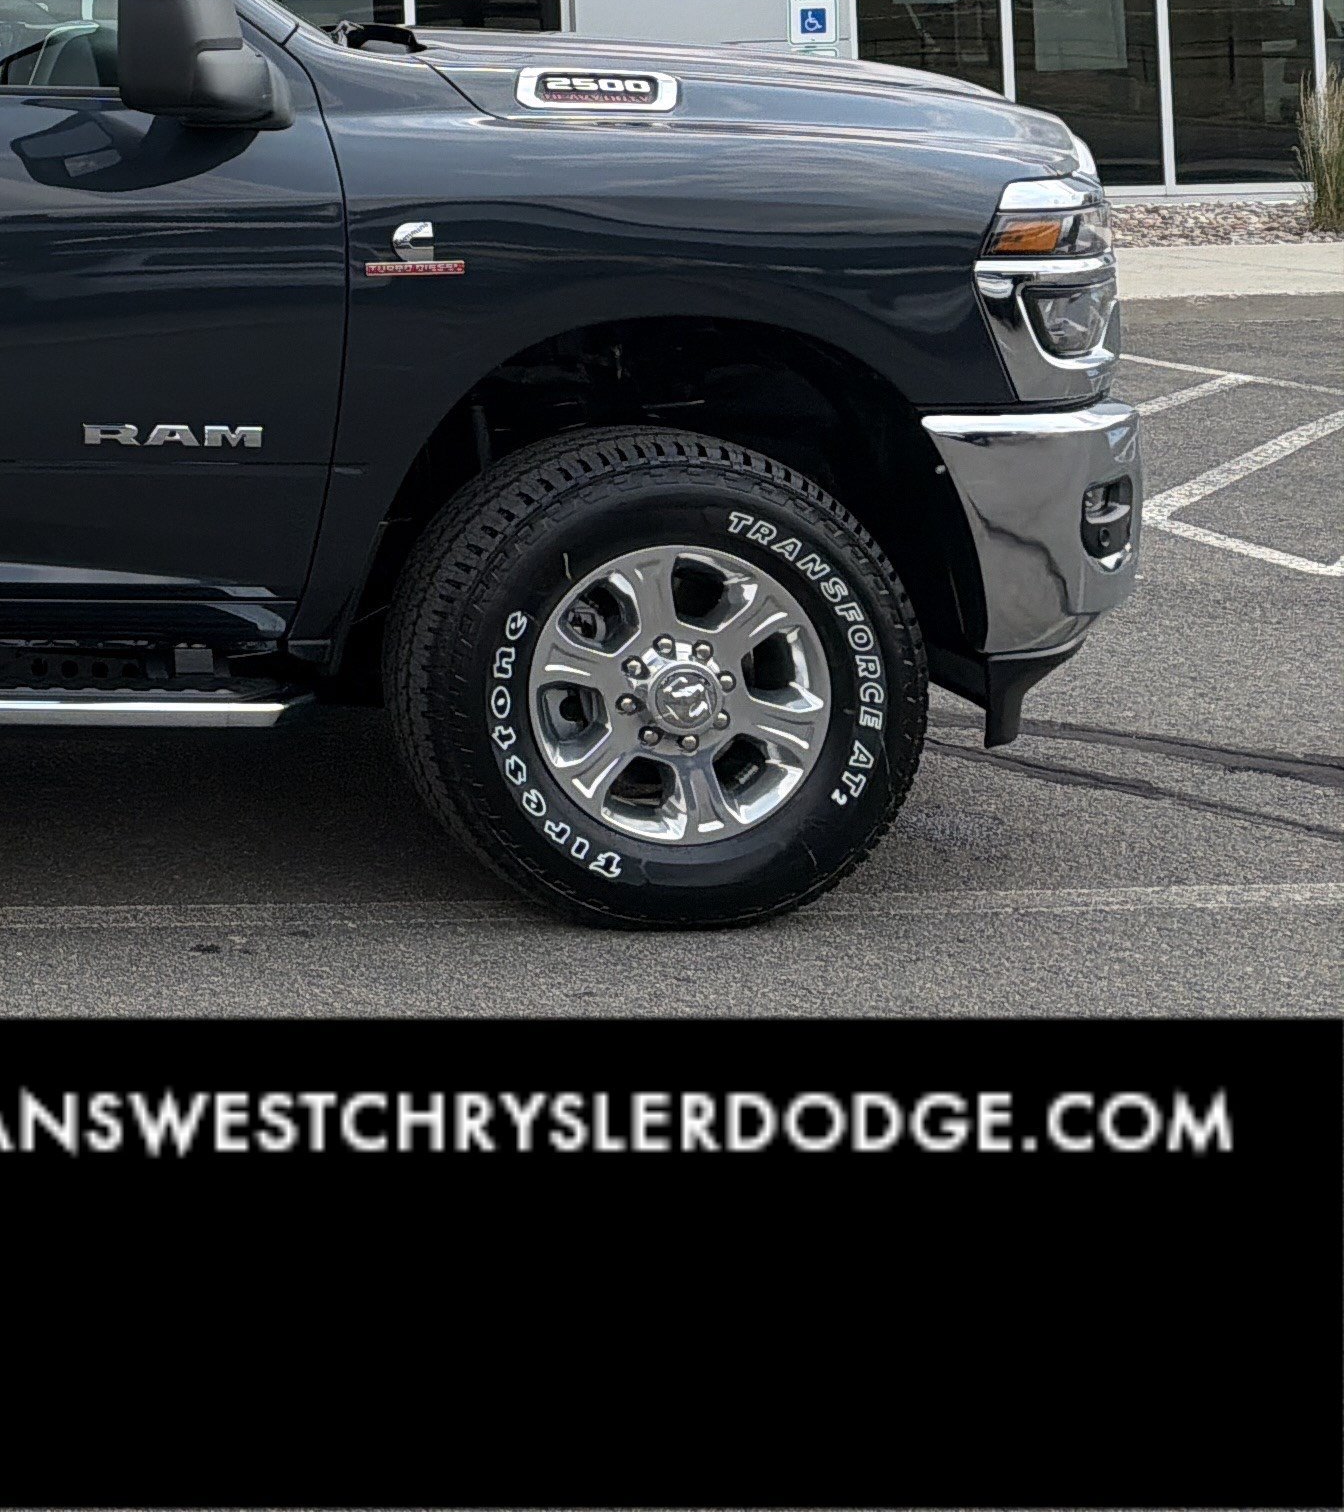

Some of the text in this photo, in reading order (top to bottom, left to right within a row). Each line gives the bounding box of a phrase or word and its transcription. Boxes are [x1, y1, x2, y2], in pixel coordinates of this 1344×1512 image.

[544, 77, 651, 93] 2500
[82, 422, 264, 448] RAM
[727, 511, 885, 731] TRANSFORCE
